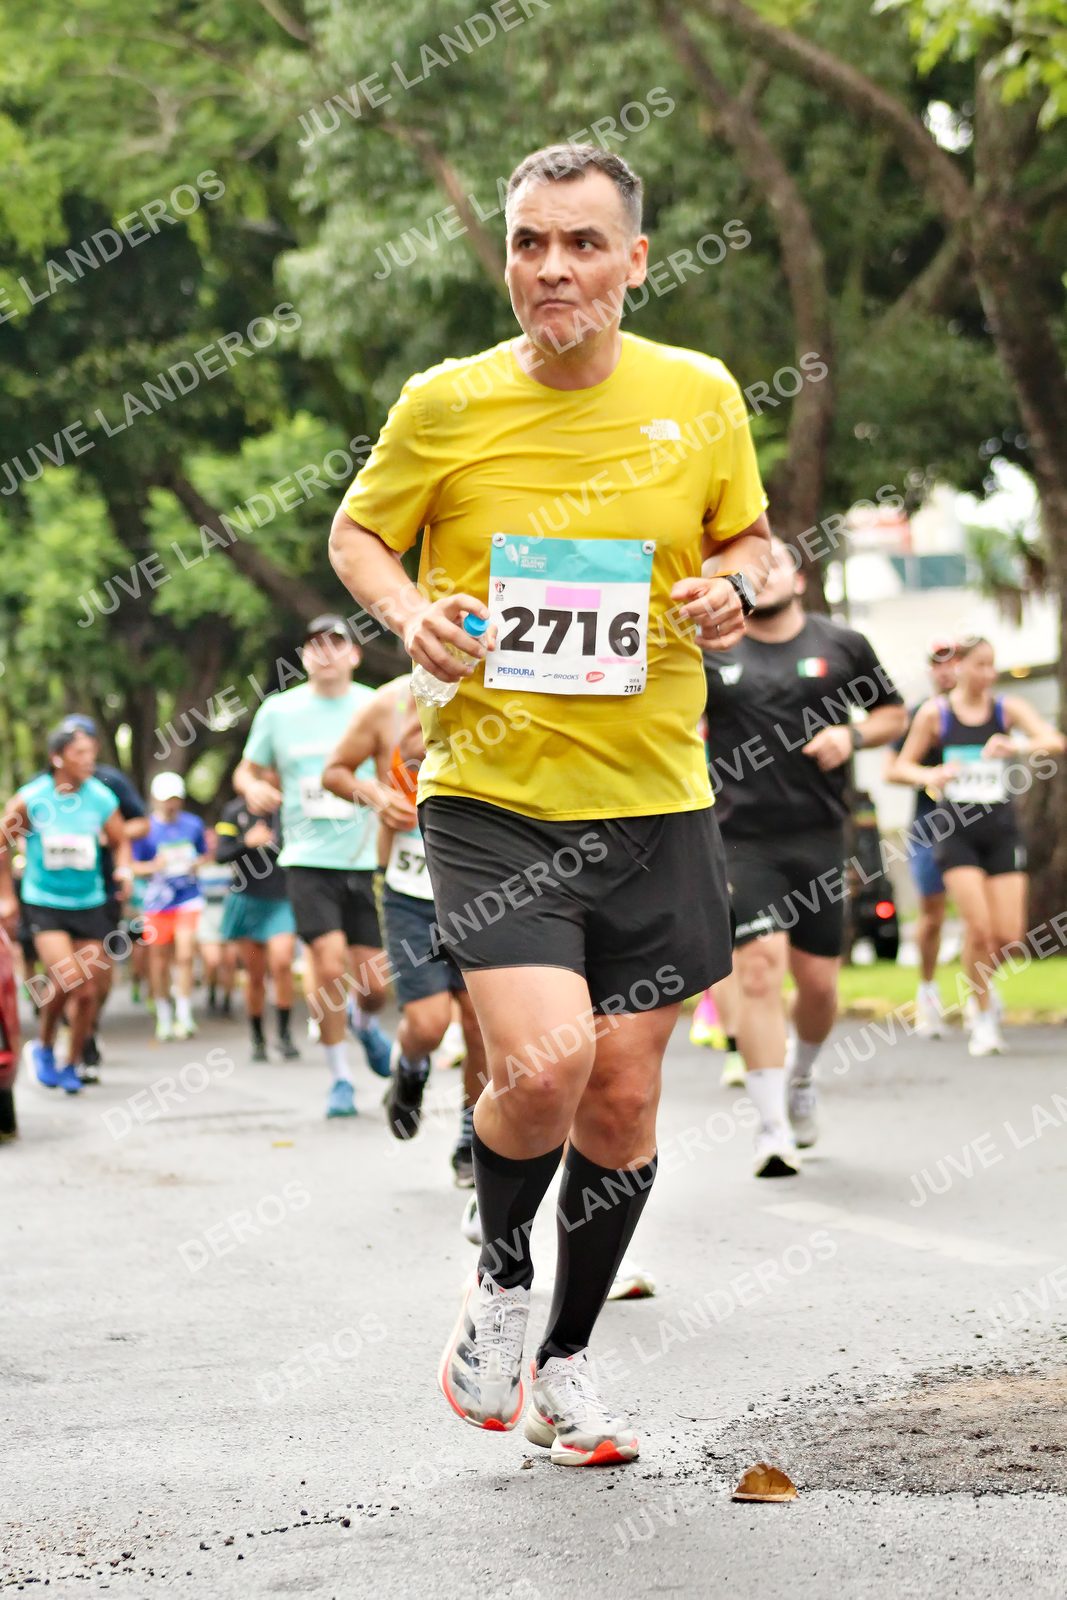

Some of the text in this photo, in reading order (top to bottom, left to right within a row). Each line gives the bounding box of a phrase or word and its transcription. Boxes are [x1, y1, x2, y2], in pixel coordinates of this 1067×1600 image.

[500, 606, 641, 657] 2716
[497, 666, 535, 677] PERDURA
[624, 684, 642, 693] 2716
